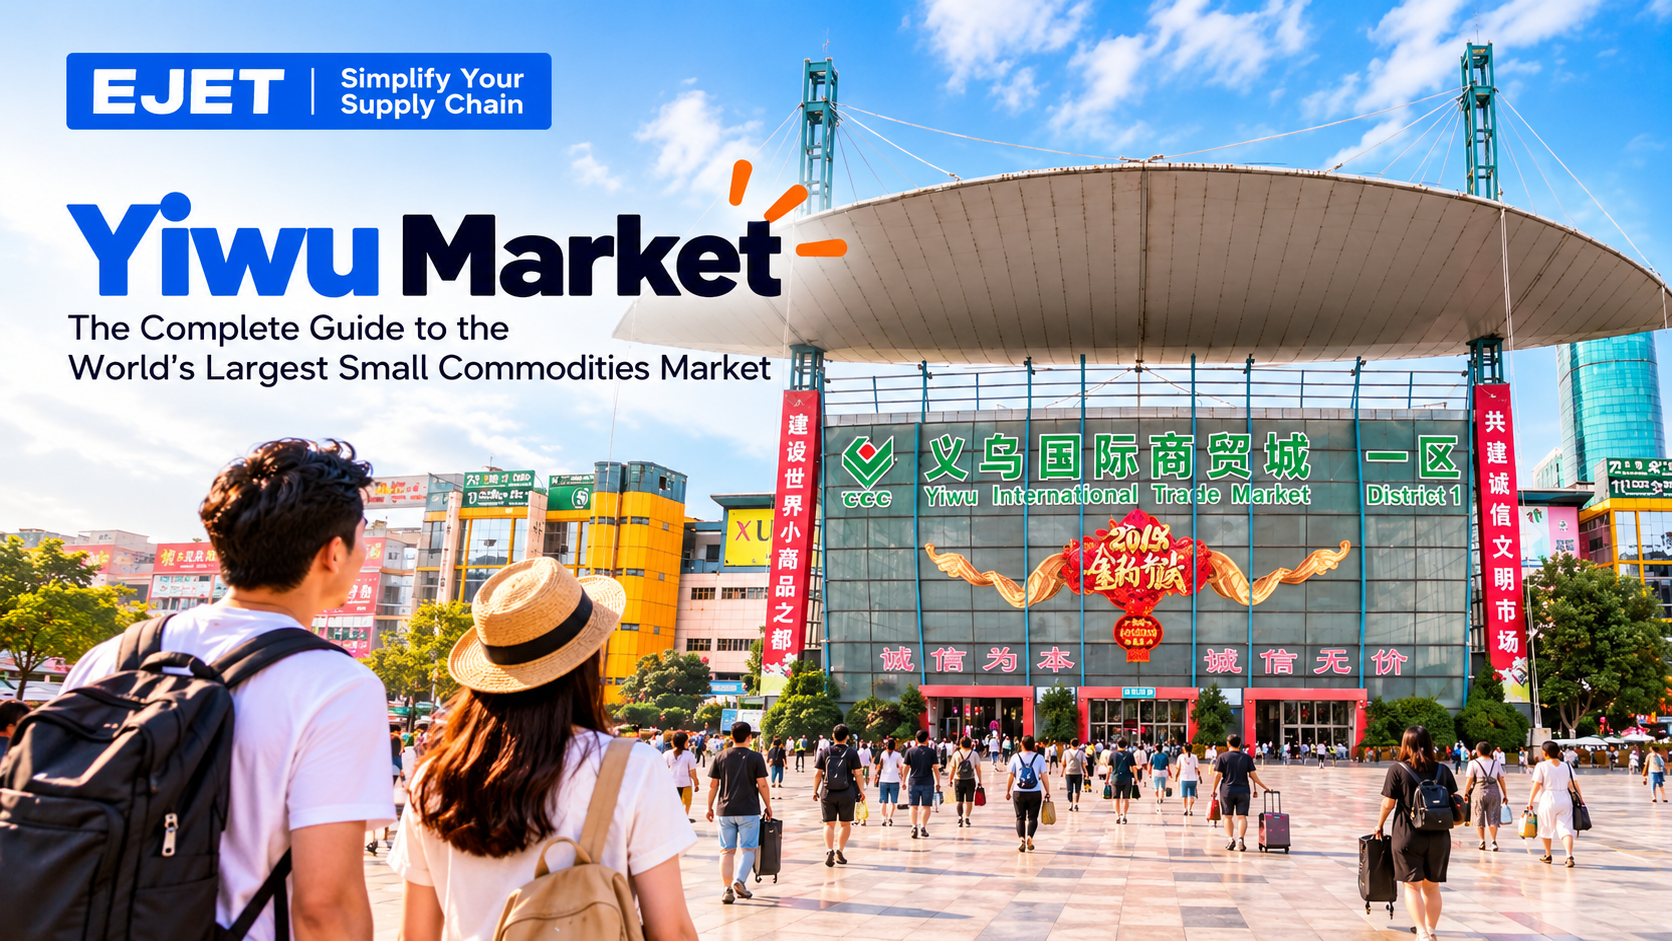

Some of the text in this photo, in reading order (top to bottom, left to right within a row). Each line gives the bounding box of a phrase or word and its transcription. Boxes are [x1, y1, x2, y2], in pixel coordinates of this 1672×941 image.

[923, 431, 1461, 482] 义乌国际商贸城 一区
[923, 483, 1461, 507] Yiwu International Trade Market District 1
[770, 412, 810, 653] 建设世界小商品之都
[1484, 409, 1520, 655] 共建诚信文明市场
[880, 645, 1076, 673] 诚信为本
[1203, 647, 1408, 676] 诚信无价
